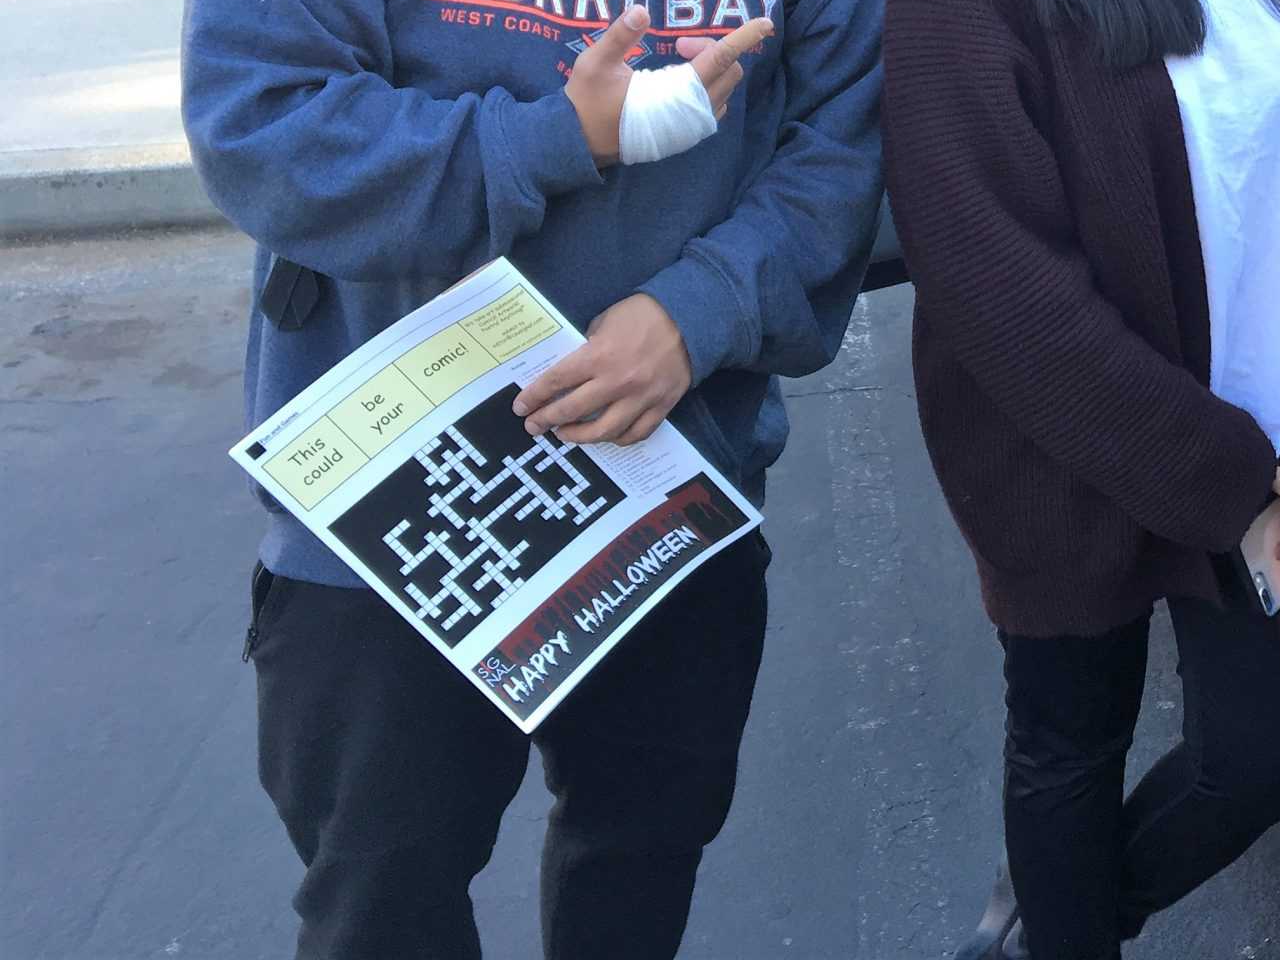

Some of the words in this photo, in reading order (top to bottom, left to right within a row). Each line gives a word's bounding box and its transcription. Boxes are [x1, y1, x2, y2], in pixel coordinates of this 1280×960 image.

[441, 7, 495, 27] WEST
[505, 15, 561, 42] COAST
[423, 342, 469, 377] comic!
[361, 393, 386, 413] be
[370, 402, 404, 435] your
[287, 438, 326, 467] This
[303, 448, 344, 486] could
[502, 630, 572, 703] HAPPY
[573, 525, 700, 634] HALLOWEEN
